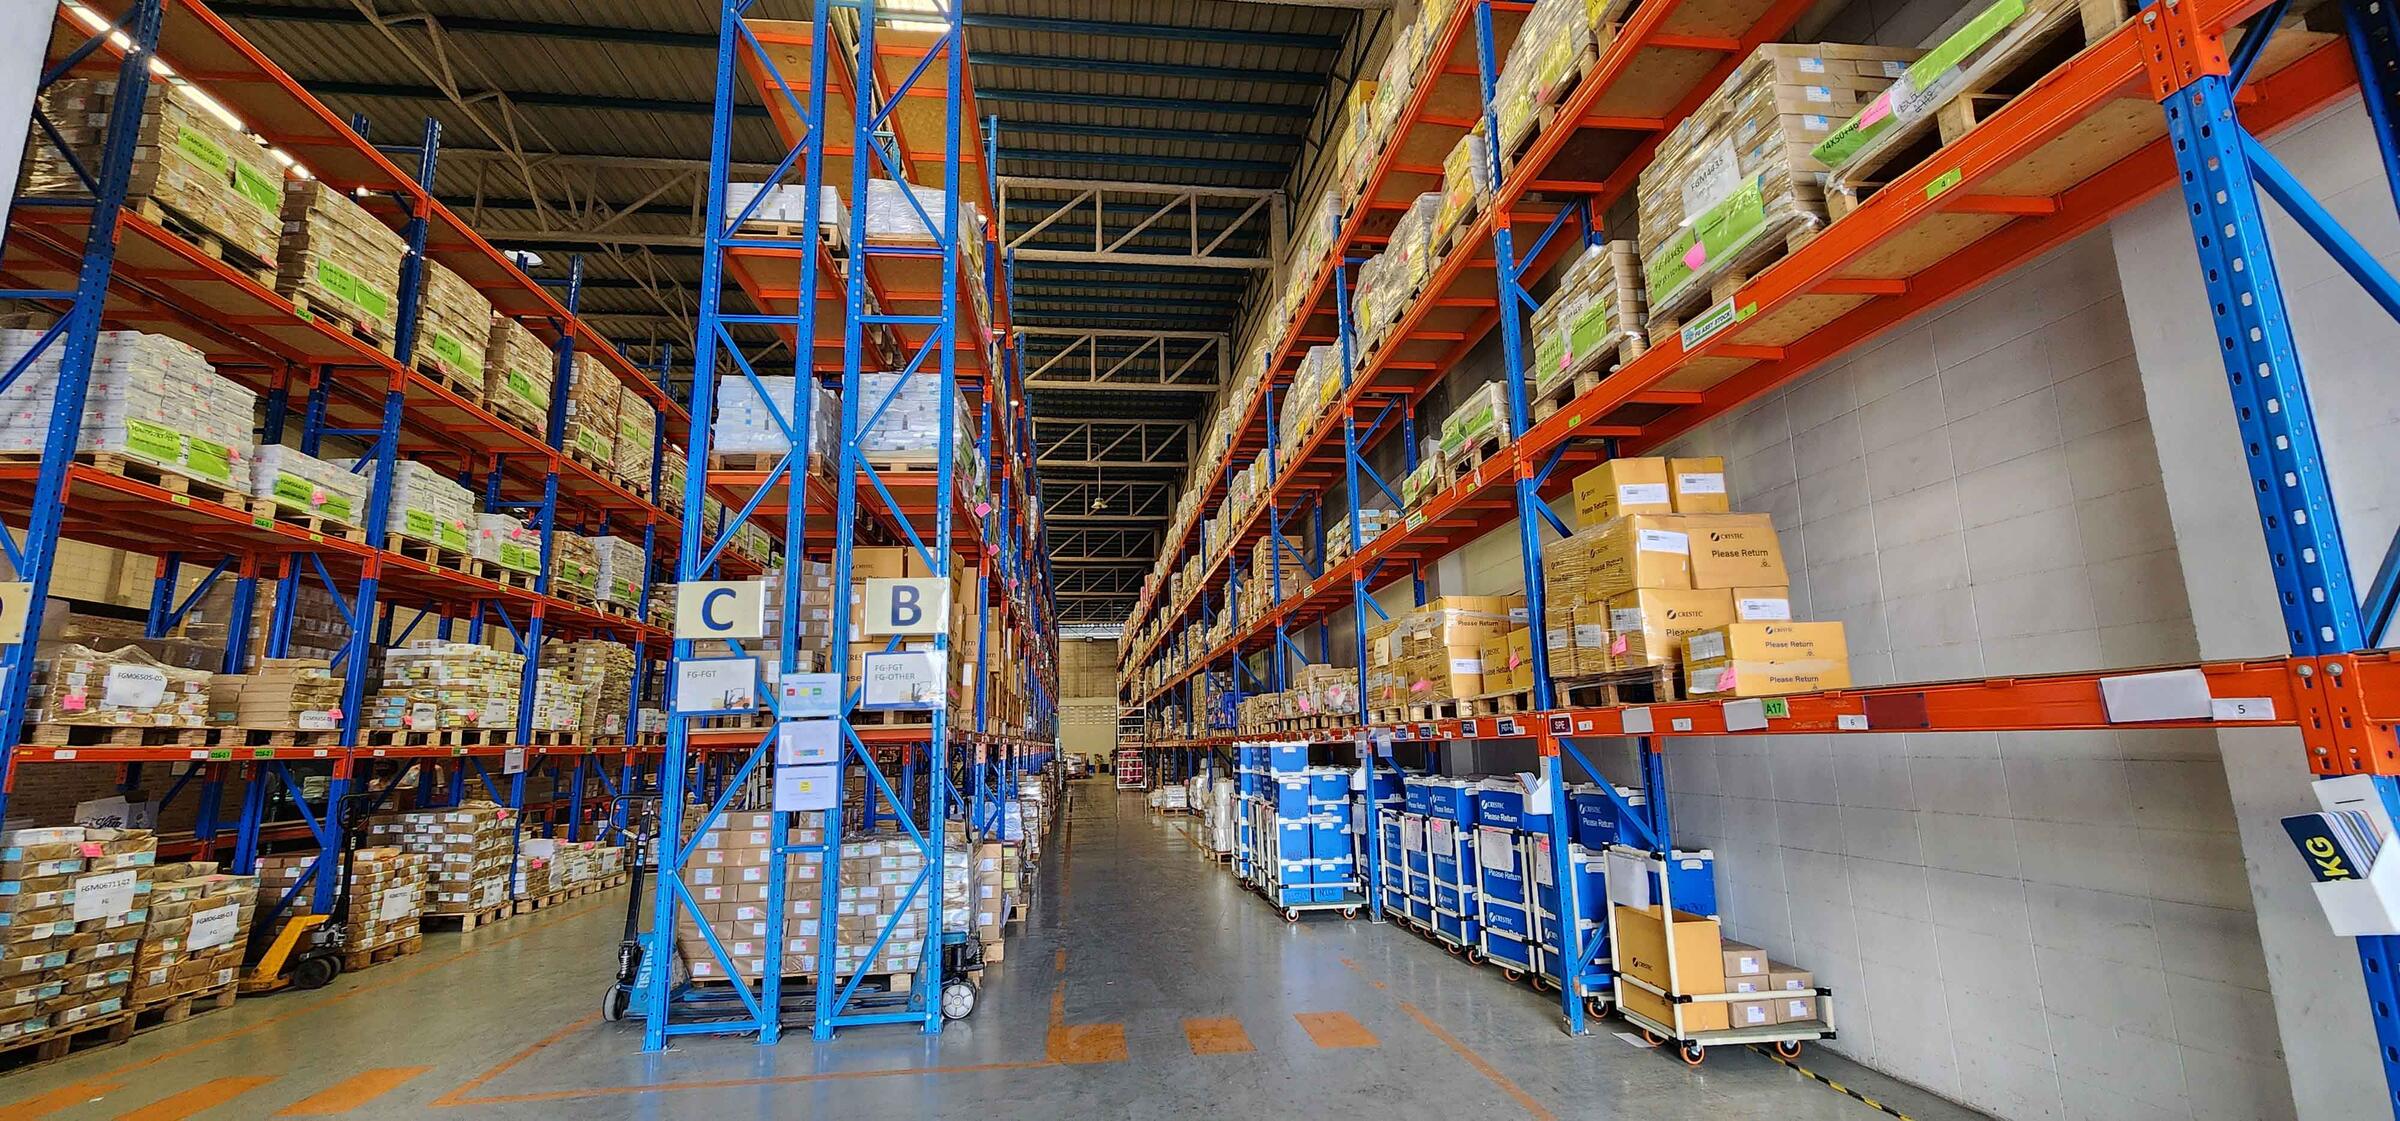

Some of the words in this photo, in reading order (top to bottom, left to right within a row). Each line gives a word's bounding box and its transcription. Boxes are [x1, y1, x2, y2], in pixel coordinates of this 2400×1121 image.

[1711, 549, 1740, 558] Please
[1741, 549, 1769, 558] Return
[702, 587, 737, 631] C
[891, 585, 923, 627] B
[1677, 610, 1704, 618] CRESTEC
[1457, 619, 1478, 627] Please
[1479, 619, 1499, 627] Return
[1790, 640, 1814, 648] Return
[874, 663, 904, 672] FG-FGT
[687, 670, 717, 679] FG-FGT
[874, 673, 916, 681] FG-OTHER
[1769, 676, 1793, 684] Please
[1795, 675, 1820, 683] Return
[1765, 703, 1783, 715] A17
[2238, 704, 2246, 715] 5
[1554, 720, 1565, 730] SPE
[1484, 811, 1501, 821] Please
[1500, 813, 1518, 823] Return
[1582, 817, 1598, 826] Please
[1598, 818, 1615, 829] Return
[1487, 868, 1505, 879] Please
[1504, 871, 1522, 882] Return
